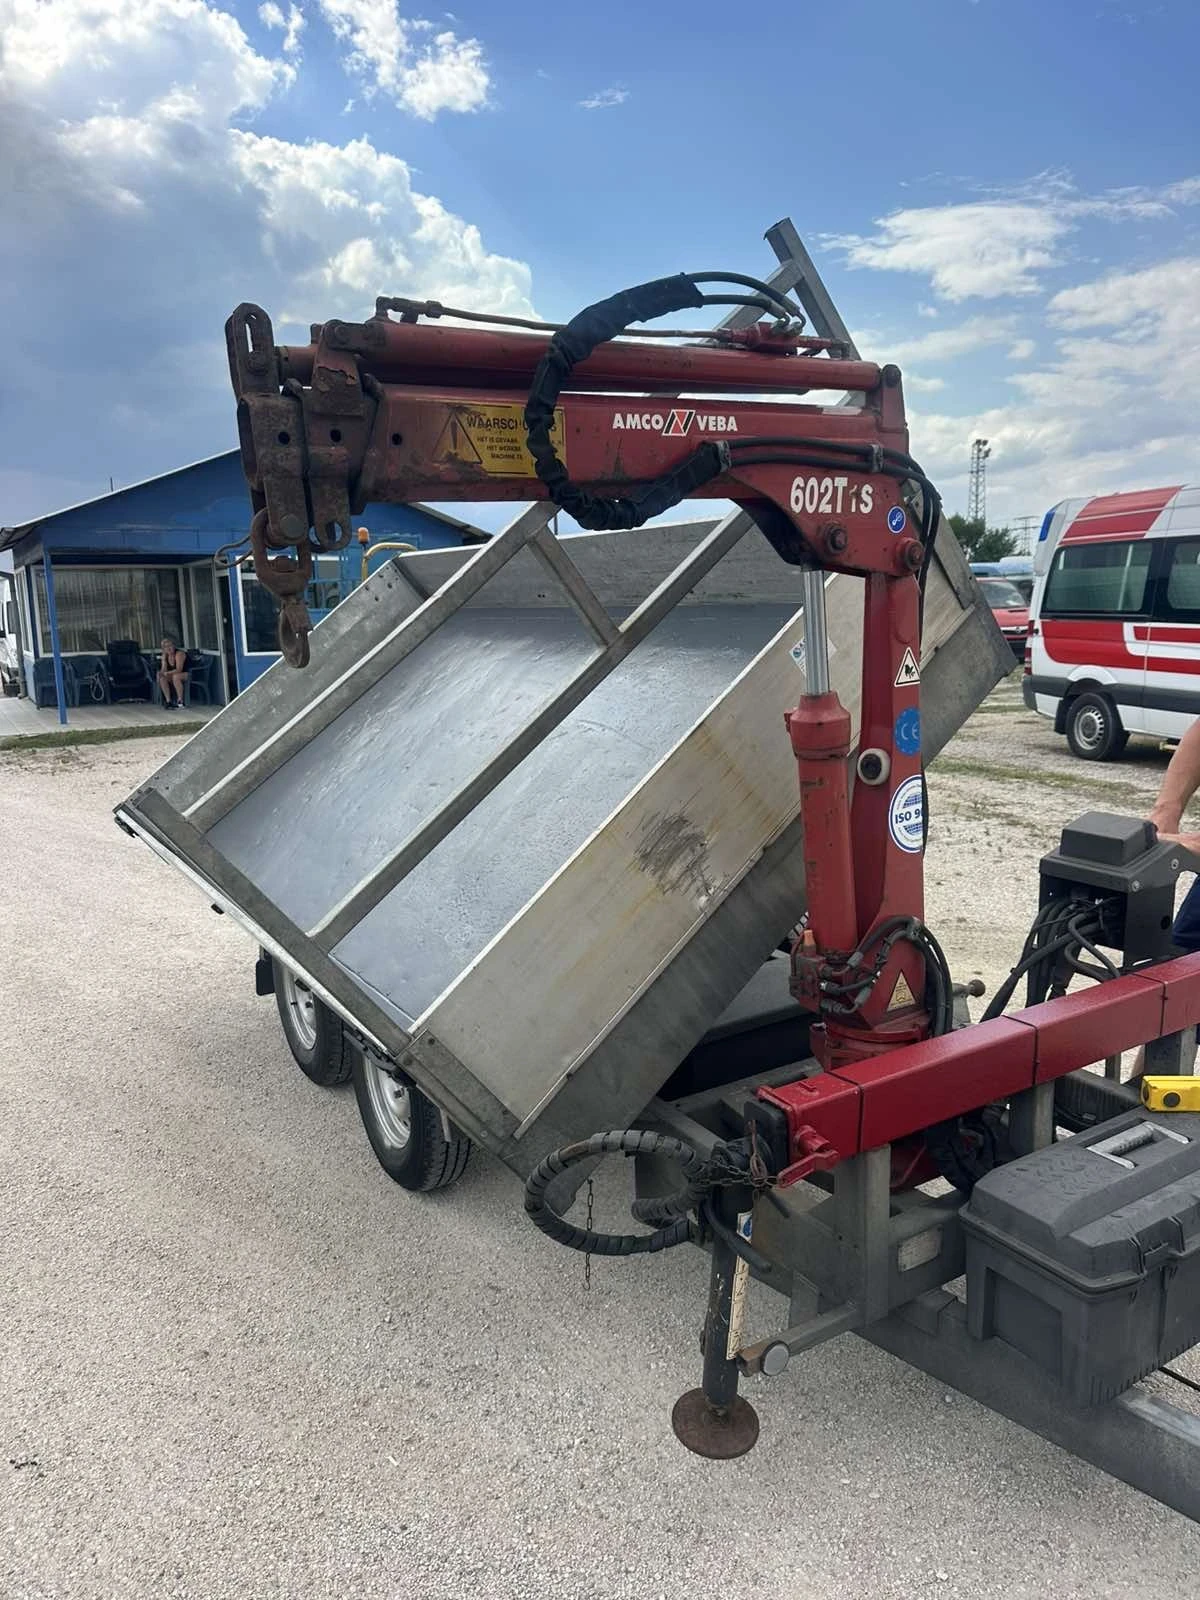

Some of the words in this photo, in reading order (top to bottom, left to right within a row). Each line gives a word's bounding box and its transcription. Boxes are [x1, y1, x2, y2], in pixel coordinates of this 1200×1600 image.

[612, 413, 664, 430] AMCO
[697, 415, 738, 432] VEBA
[895, 811, 912, 824] ISO
